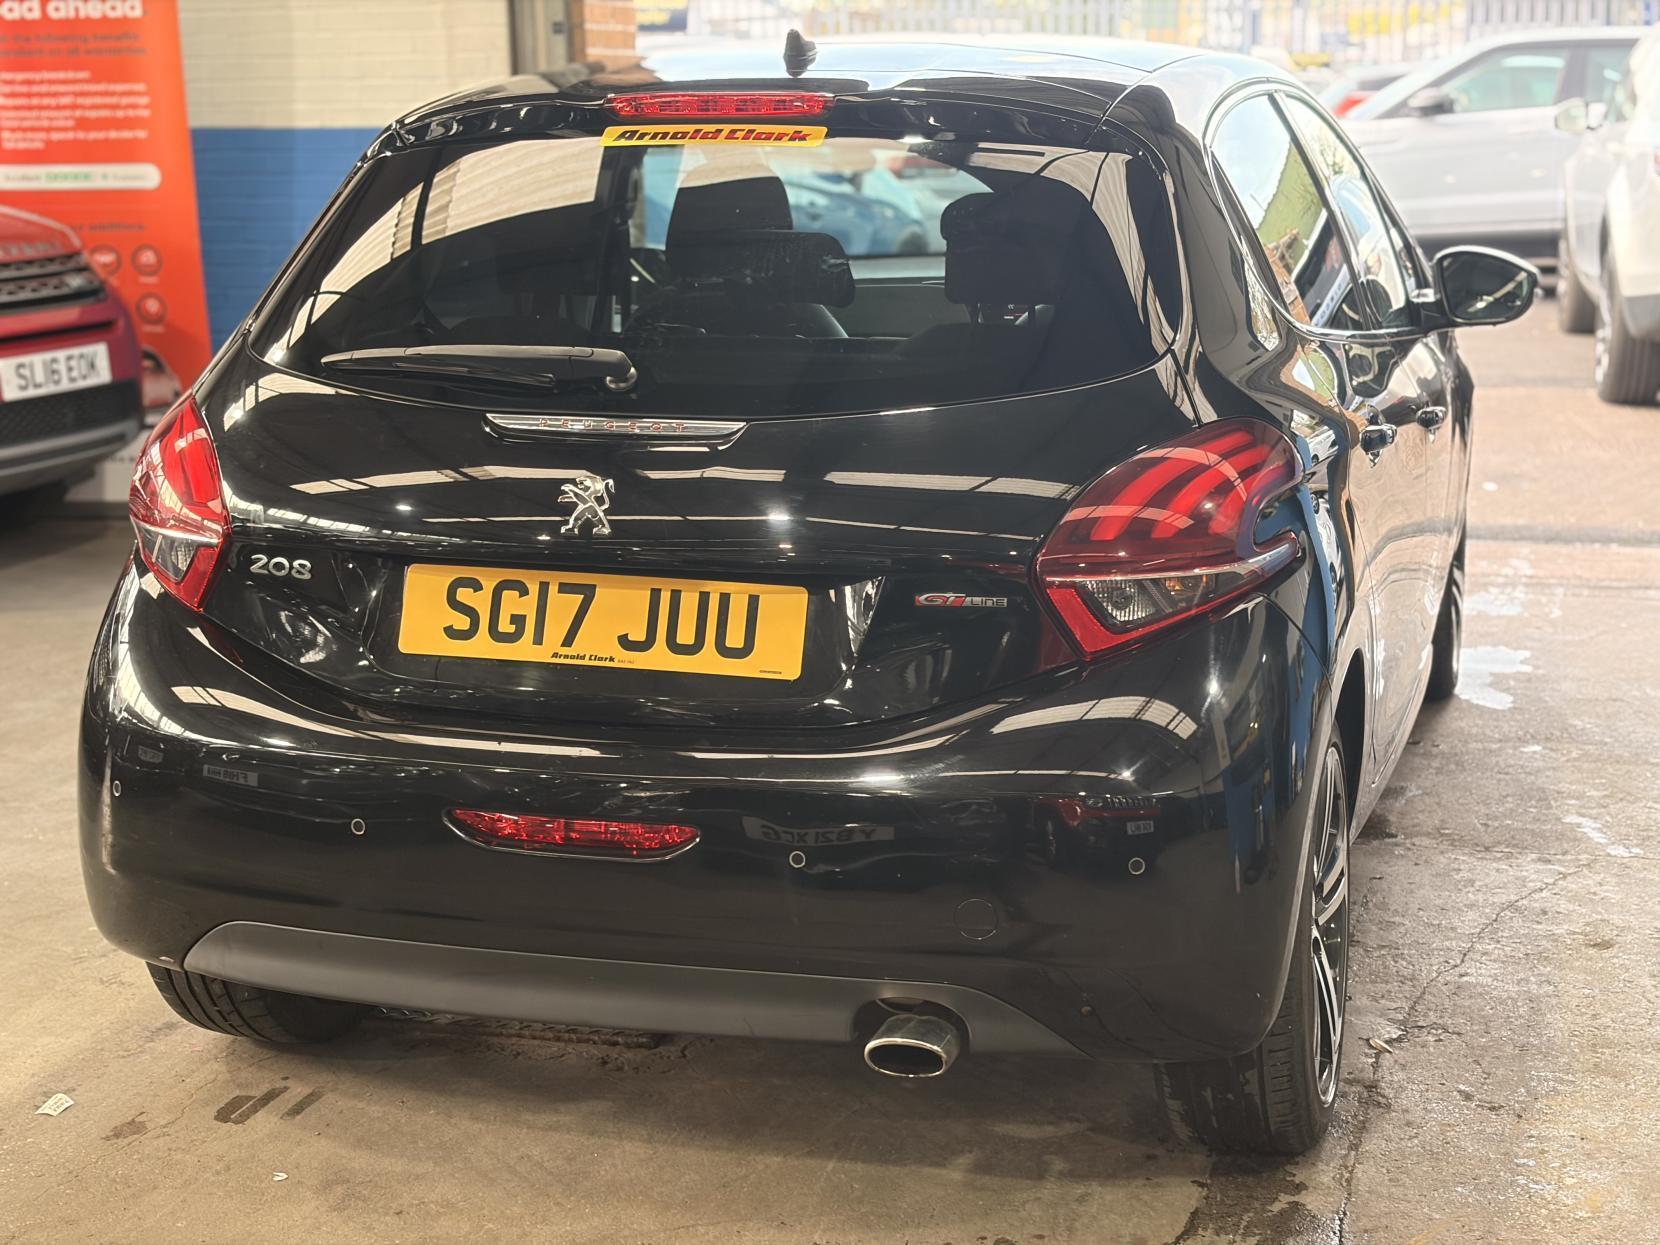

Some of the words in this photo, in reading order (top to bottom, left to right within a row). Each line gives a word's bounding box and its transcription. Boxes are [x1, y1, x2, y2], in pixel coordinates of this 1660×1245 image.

[613, 129, 720, 141] Arnold
[724, 128, 812, 142] Clark
[15, 357, 62, 391] SL16
[539, 417, 685, 433] PEUGEOT
[250, 554, 312, 579] 208
[443, 576, 597, 648] SG17
[617, 587, 760, 660] JUU
[551, 652, 586, 660] Arnold
[588, 654, 616, 662] Clark
